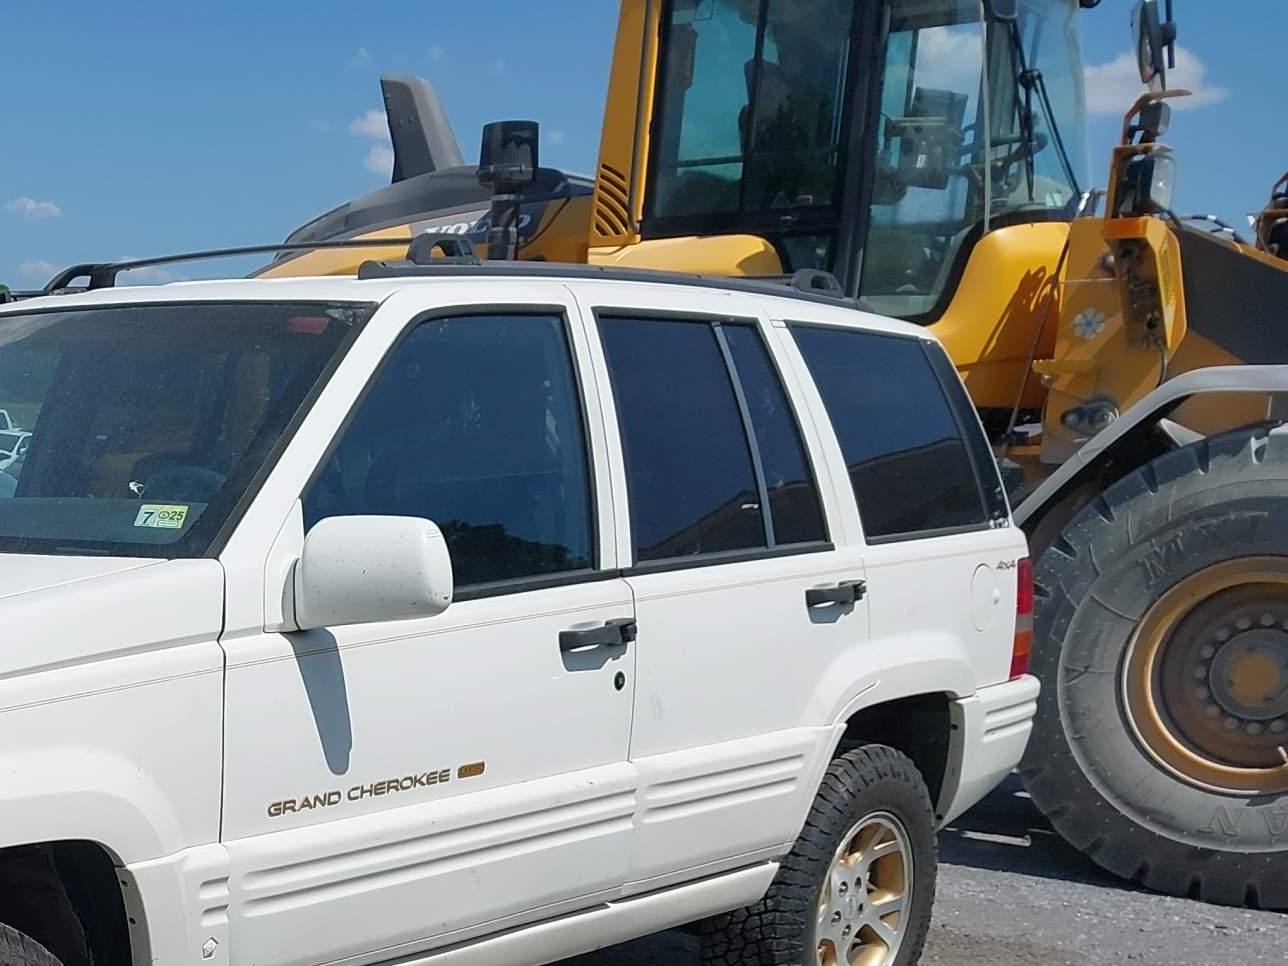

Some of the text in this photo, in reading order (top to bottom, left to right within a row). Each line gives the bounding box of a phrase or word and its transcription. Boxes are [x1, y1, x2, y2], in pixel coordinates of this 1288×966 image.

[143, 511, 185, 524] 7 25
[267, 791, 341, 818] GRAND
[347, 768, 451, 802] CHEROKEE
